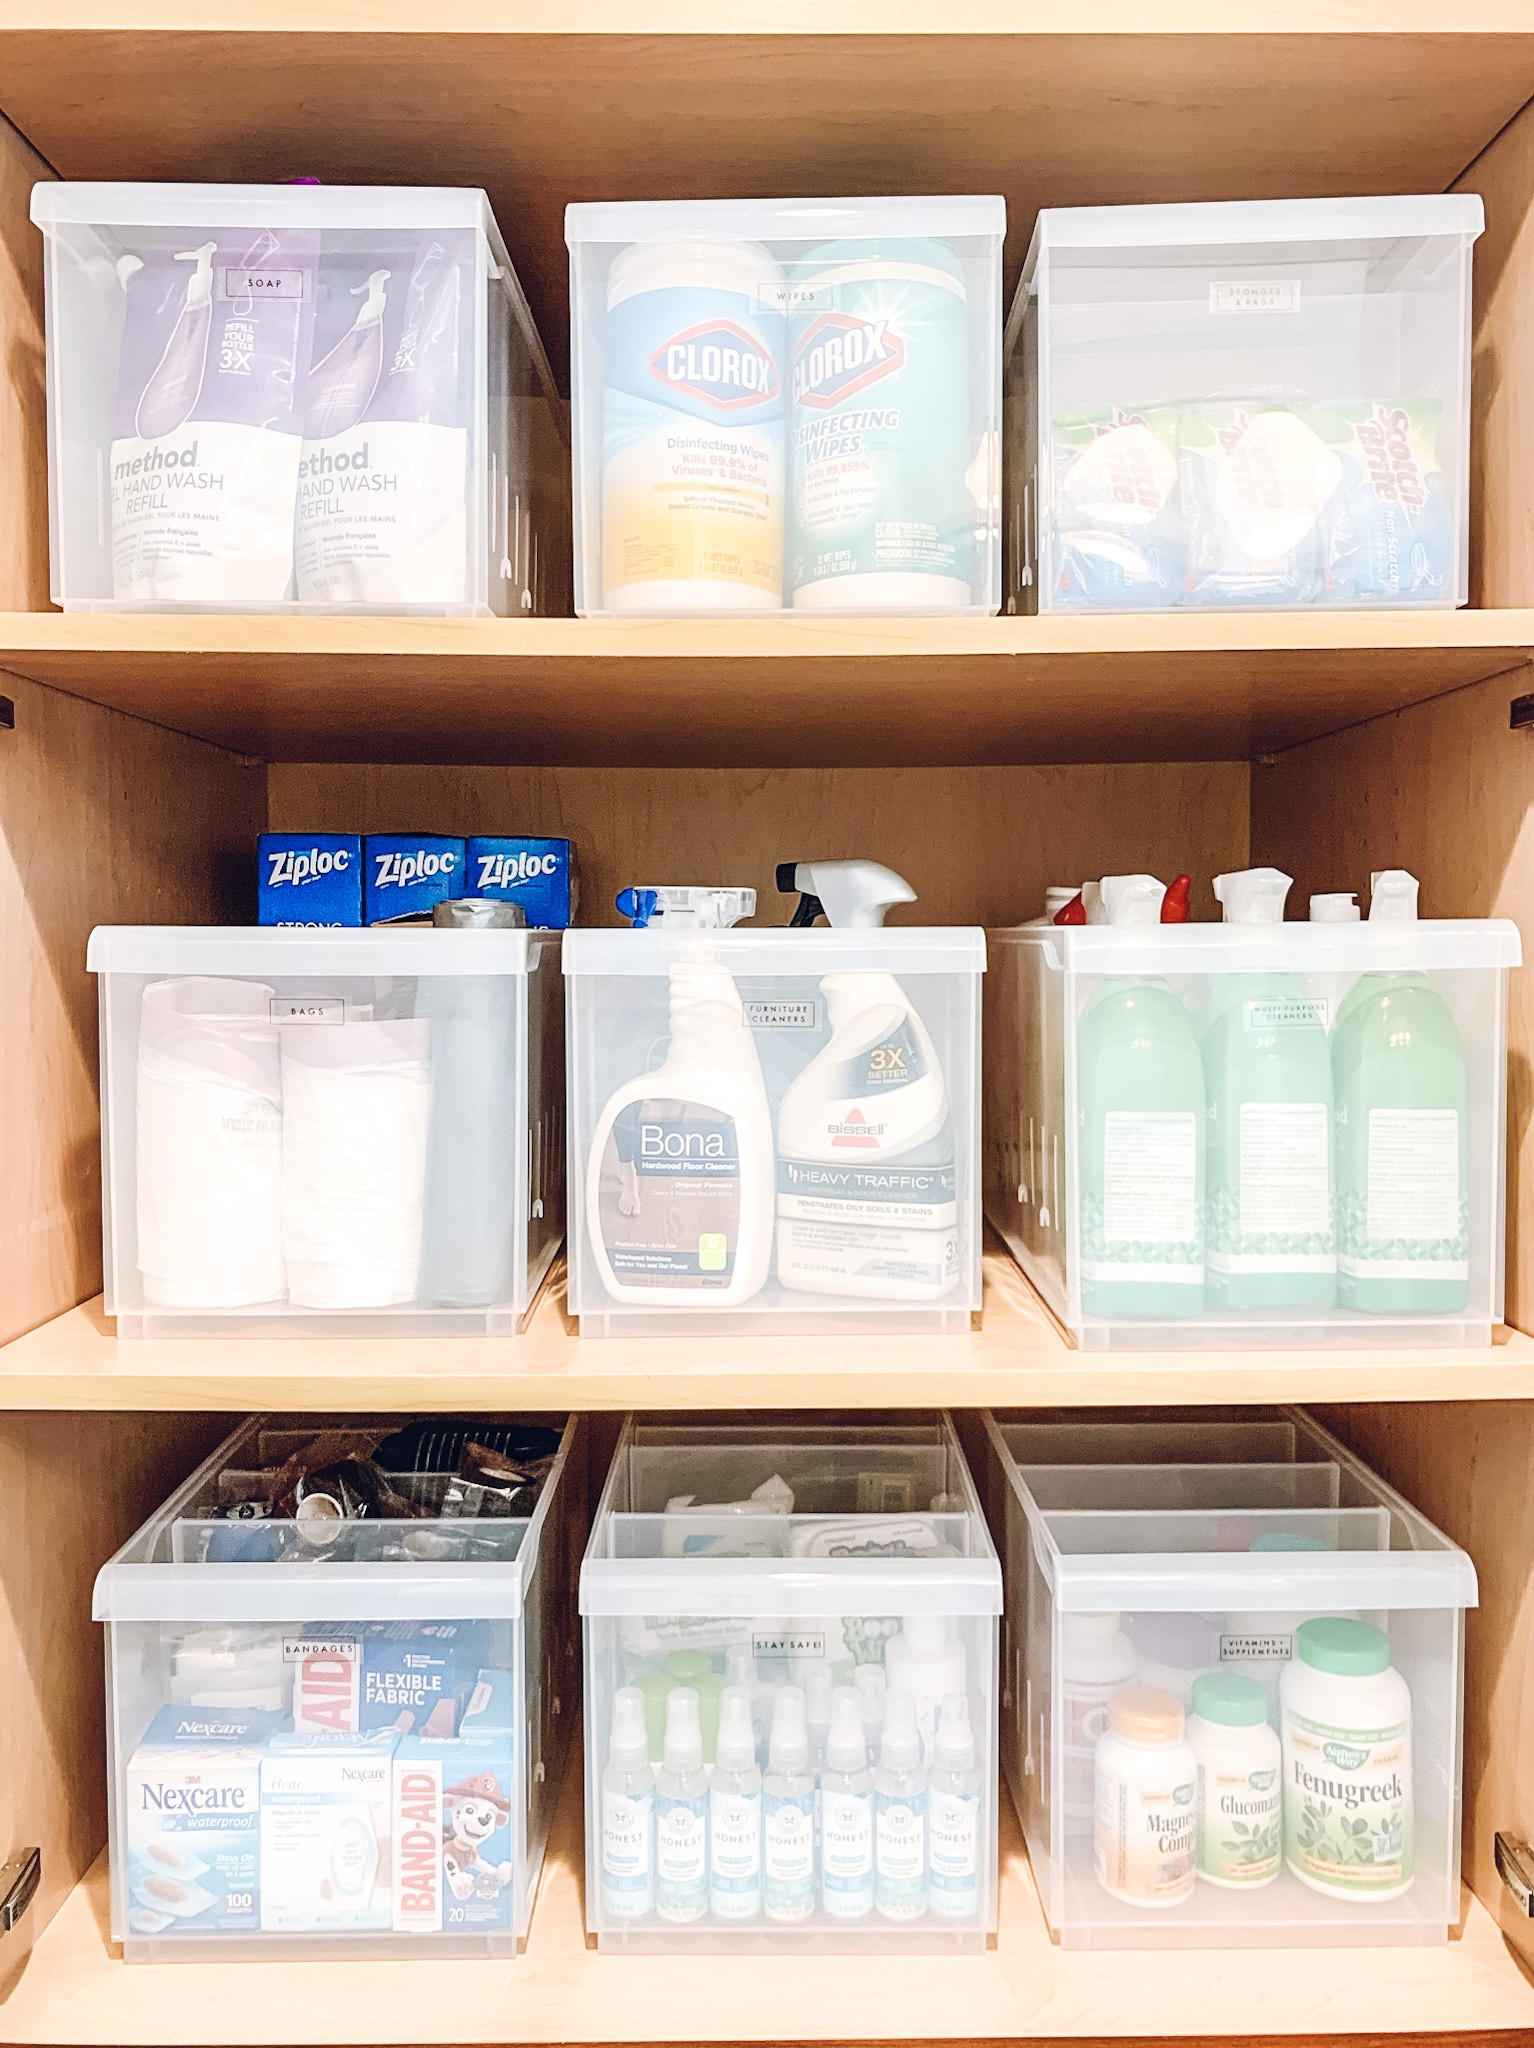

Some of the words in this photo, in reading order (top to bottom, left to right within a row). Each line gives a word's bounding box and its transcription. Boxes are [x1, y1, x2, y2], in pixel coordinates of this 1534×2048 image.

[247, 278, 282, 289] SOAP
[776, 292, 815, 301] WIPES
[1228, 287, 1281, 296] SPONGES
[225, 322, 255, 334] REFILL
[224, 332, 254, 342] YOUR
[219, 350, 253, 371] 3X
[666, 344, 770, 396] CLOROX
[667, 437, 738, 455] Disinfecting
[739, 443, 770, 462] Wipes
[805, 435, 862, 464] WIPES
[114, 440, 198, 480] method
[299, 441, 369, 479] ethod
[682, 454, 706, 464] Kills
[709, 454, 746, 470] 99.9%
[748, 463, 758, 473] of
[1357, 420, 1398, 501] Brite
[339, 473, 398, 492] WASH
[719, 468, 727, 477] &
[729, 469, 768, 487] Bacteria
[807, 468, 825, 482] Kills
[123, 475, 162, 498] HAND
[167, 472, 224, 491] WASH
[126, 492, 169, 515] REFILL
[300, 497, 345, 521] REFILL
[157, 511, 176, 519] POUR
[193, 513, 220, 522] MAINS
[370, 515, 397, 523] MAINS
[268, 847, 349, 886] Ziploc
[375, 850, 455, 888] Ziploc
[477, 851, 557, 889] Ziploc
[291, 1007, 324, 1016] BAGS
[750, 1005, 808, 1014] FURNITURE
[751, 1014, 807, 1023] CLEANERS
[869, 1048, 906, 1070] 3X
[867, 1069, 908, 1079] BETTER
[641, 1125, 726, 1157] Bona
[641, 1161, 682, 1170] Hardwood
[683, 1162, 704, 1171] Floor
[705, 1162, 736, 1171] Cleaner
[800, 1170, 850, 1185] HEAVY
[854, 1174, 930, 1190] TRAFFIC
[797, 1199, 845, 1211] PENETRATES
[845, 1204, 864, 1212] OILY
[866, 1205, 891, 1213] SOILS
[901, 1207, 933, 1216] STAINS
[858, 1230, 879, 1239] tough
[286, 1644, 353, 1653] BANDAGES
[756, 1641, 785, 1649] STAY
[789, 1641, 821, 1649] SAFE!
[1228, 1639, 1276, 1647] VITAMINS
[1223, 1648, 1289, 1656] SUPPLEMENTS
[365, 1671, 443, 1692] FLEXIBLE
[301, 1651, 353, 1732] AID
[365, 1687, 425, 1706] FABRIC
[176, 1720, 248, 1736] Nexcare
[184, 1775, 201, 1785] 3M
[342, 1767, 386, 1783] Nexcare
[270, 1777, 303, 1790] clear
[1294, 1759, 1403, 1810] Fenugreek
[141, 1783, 246, 1816] Nexcare
[270, 1794, 321, 1806] waterproof
[187, 1814, 254, 1830] waterproof
[400, 1773, 437, 1912] BAND-AID
[603, 1829, 644, 1843] HONEST
[660, 1834, 703, 1848] HONEST
[714, 1831, 757, 1844] HONEST
[768, 1832, 810, 1847] HONEST
[826, 1829, 869, 1843] HONEST
[878, 1831, 922, 1845] HONEST
[931, 1827, 972, 1843] HONEST
[216, 1853, 240, 1863] Stays
[240, 1853, 255, 1862] On
[225, 1893, 252, 1907] 100
[448, 1907, 465, 1922] 20
